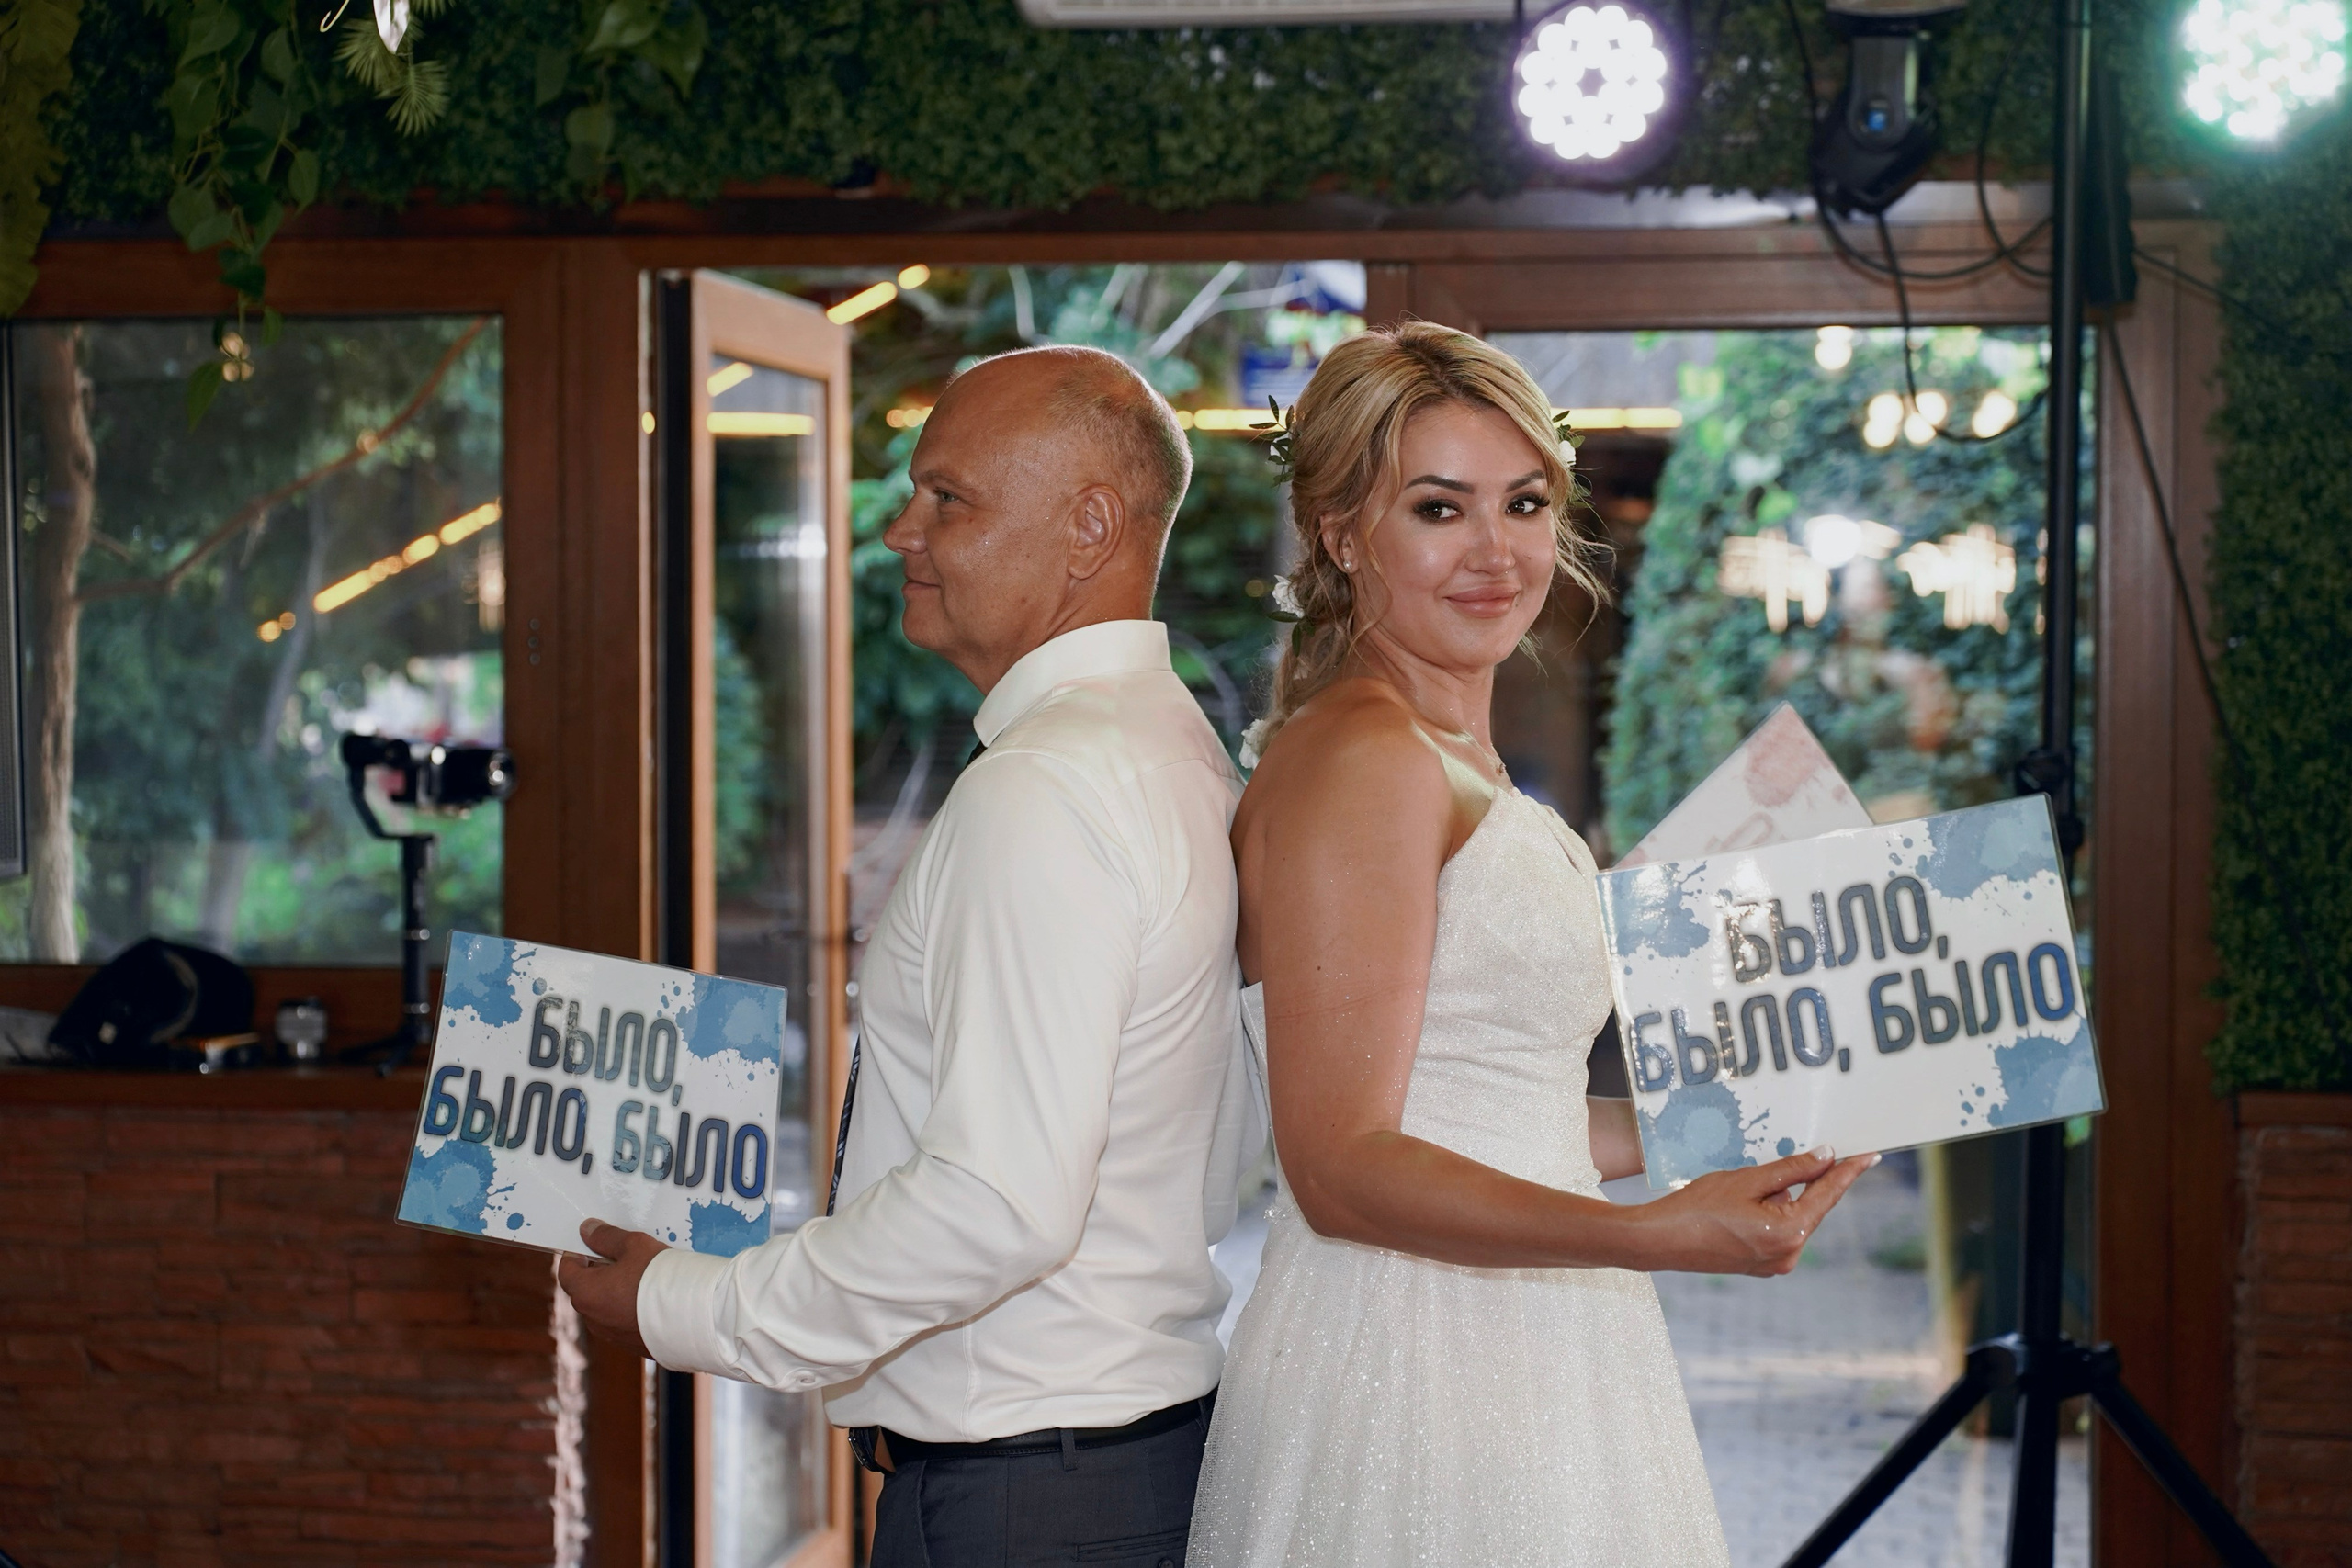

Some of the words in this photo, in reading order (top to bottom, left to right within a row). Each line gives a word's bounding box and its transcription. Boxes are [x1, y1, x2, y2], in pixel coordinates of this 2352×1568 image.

[1724, 875, 1949, 983] БЫЛО,
[527, 995, 684, 1107] БЫЛО,
[1631, 987, 1851, 1093] БЫЛО,
[1869, 942, 2076, 1054] БЫЛО
[423, 1065, 594, 1175] БЫЛО,
[612, 1100, 768, 1199] БЫЛО
